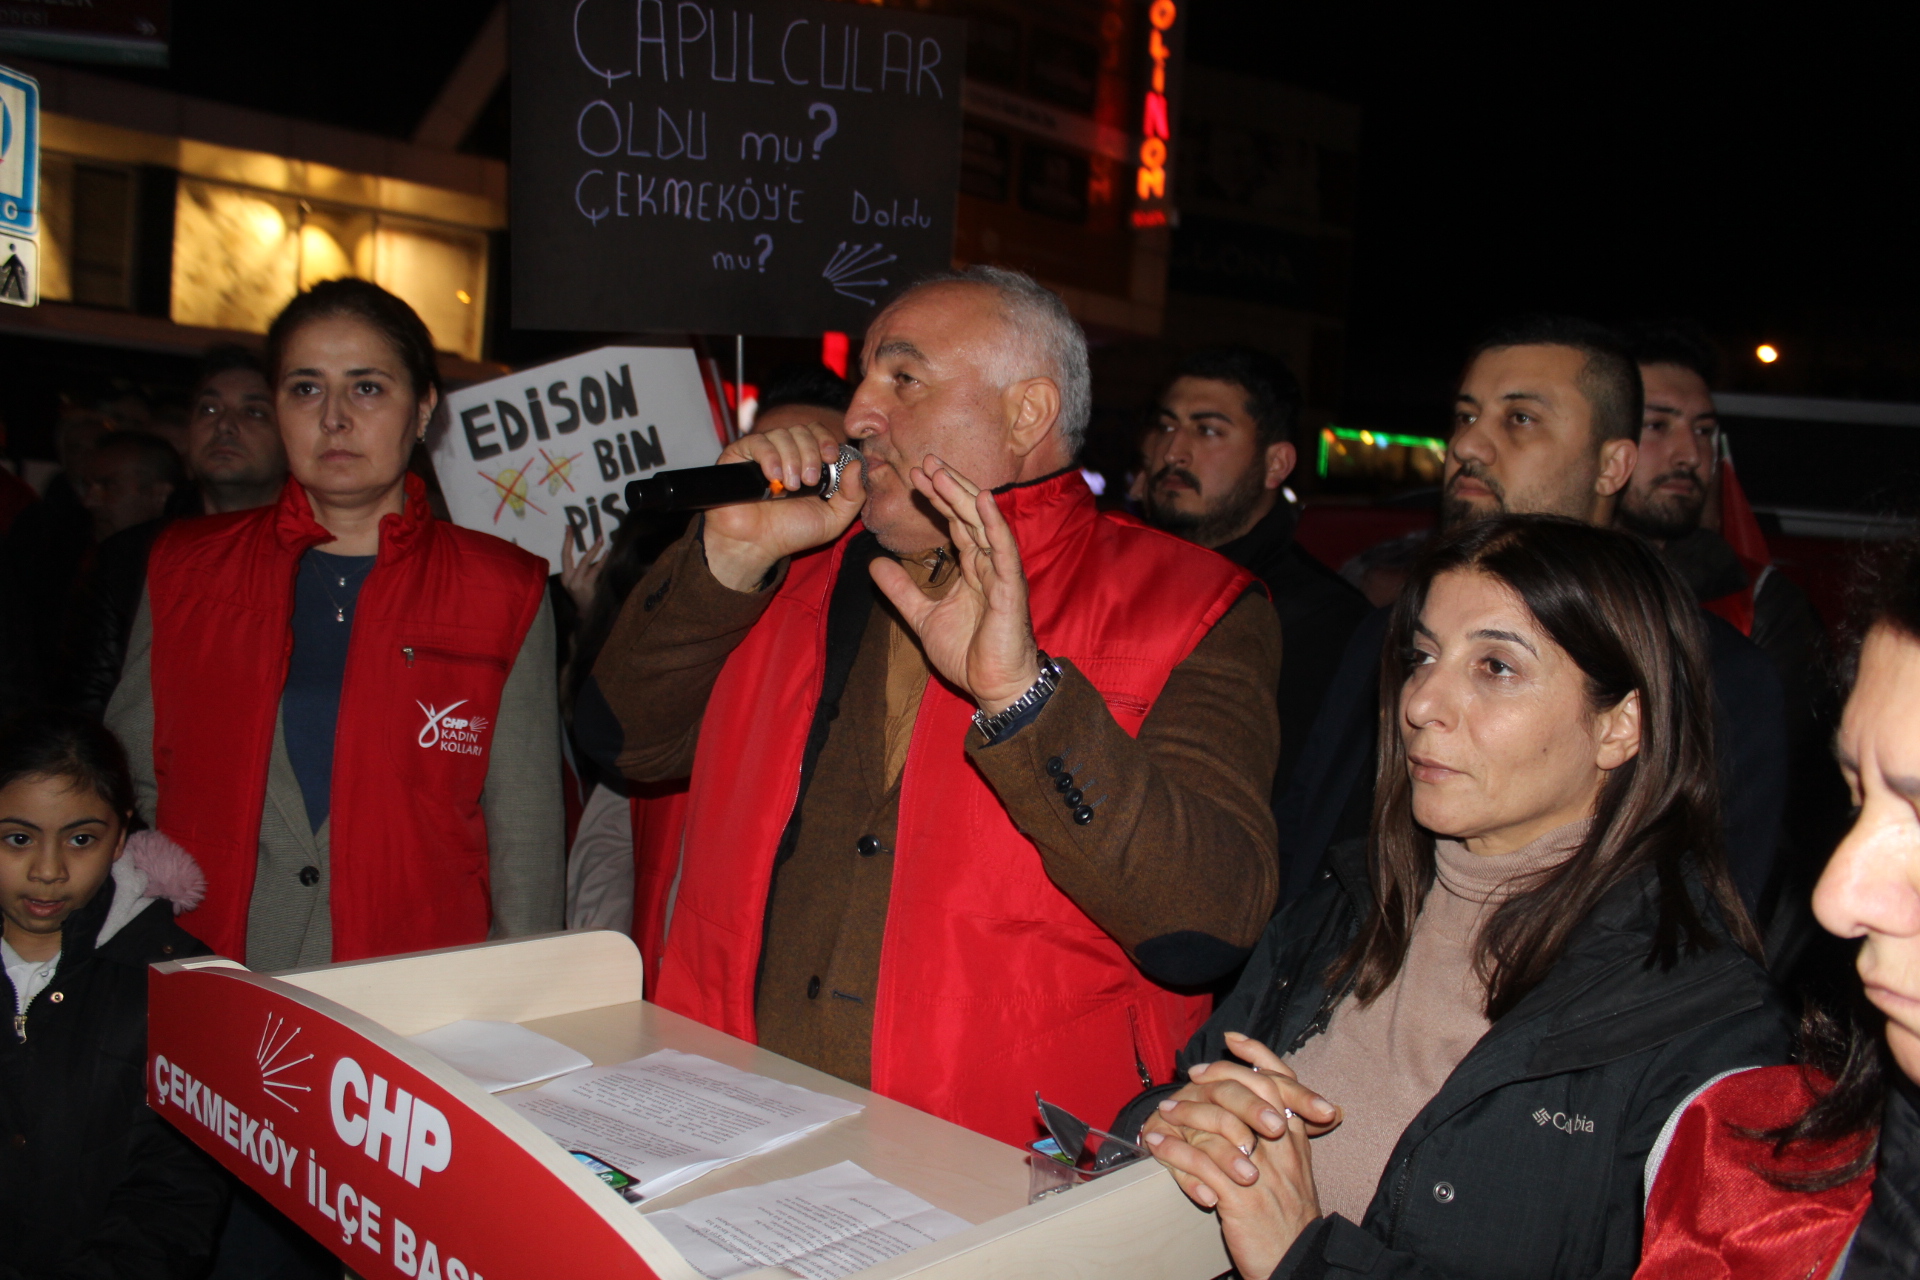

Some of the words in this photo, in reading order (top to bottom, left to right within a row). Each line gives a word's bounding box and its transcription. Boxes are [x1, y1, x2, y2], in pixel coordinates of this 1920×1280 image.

[573, 0, 943, 98] ÇAPULCULAR
[576, 100, 706, 160] OLDU
[740, 102, 838, 163] mu?
[574, 169, 804, 227] ÇEKMEKÖY'E
[851, 190, 932, 229] Doldu
[711, 233, 774, 273] mu?
[440, 741, 482, 756] KOLLARI
[441, 729, 478, 743] KADIN
[442, 717, 469, 729] CHP
[330, 1056, 453, 1189] CHP
[155, 1054, 299, 1189] ÇEKMEKÖY
[307, 1148, 382, 1255] İLÇE
